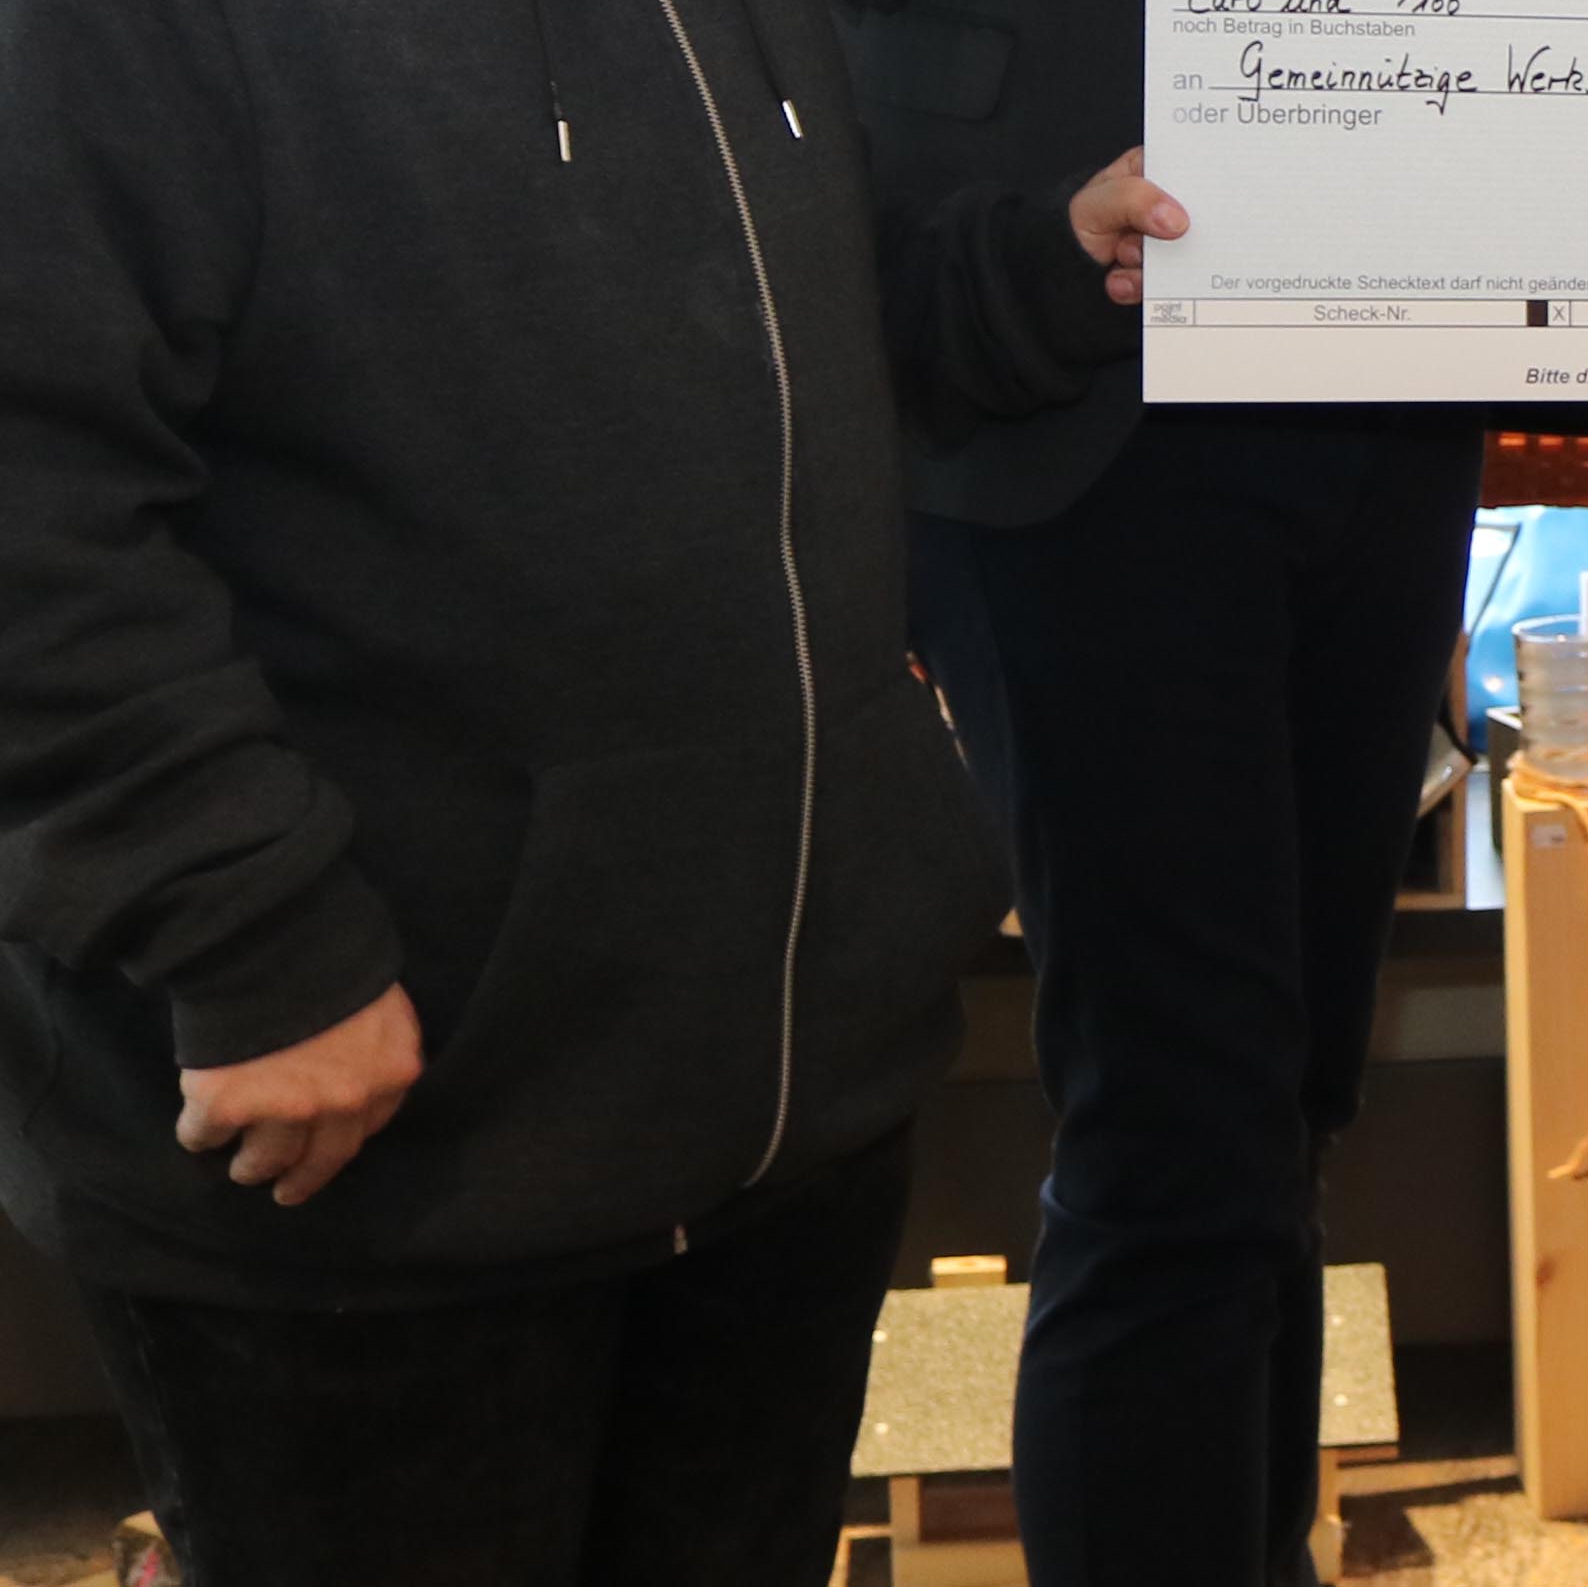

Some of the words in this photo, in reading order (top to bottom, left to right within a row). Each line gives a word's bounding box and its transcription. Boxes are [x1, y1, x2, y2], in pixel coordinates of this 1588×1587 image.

[1172, 18, 1218, 34] noch
[1223, 18, 1282, 37] Betrag
[1288, 19, 1304, 35] in
[1310, 19, 1416, 37] Buchstaben
[1172, 73, 1203, 91] an
[1173, 104, 1229, 125] oder
[1236, 100, 1383, 131] Überbringer
[1211, 274, 1241, 290] Der
[1246, 274, 1352, 294] vorgedruckte
[1357, 274, 1445, 291] Schecktext
[1450, 274, 1481, 291] darf
[1486, 275, 1524, 291] nicht
[1313, 304, 1411, 322] Scheck-Nr.
[1552, 306, 1565, 322] X
[1525, 368, 1571, 385] Bitte
